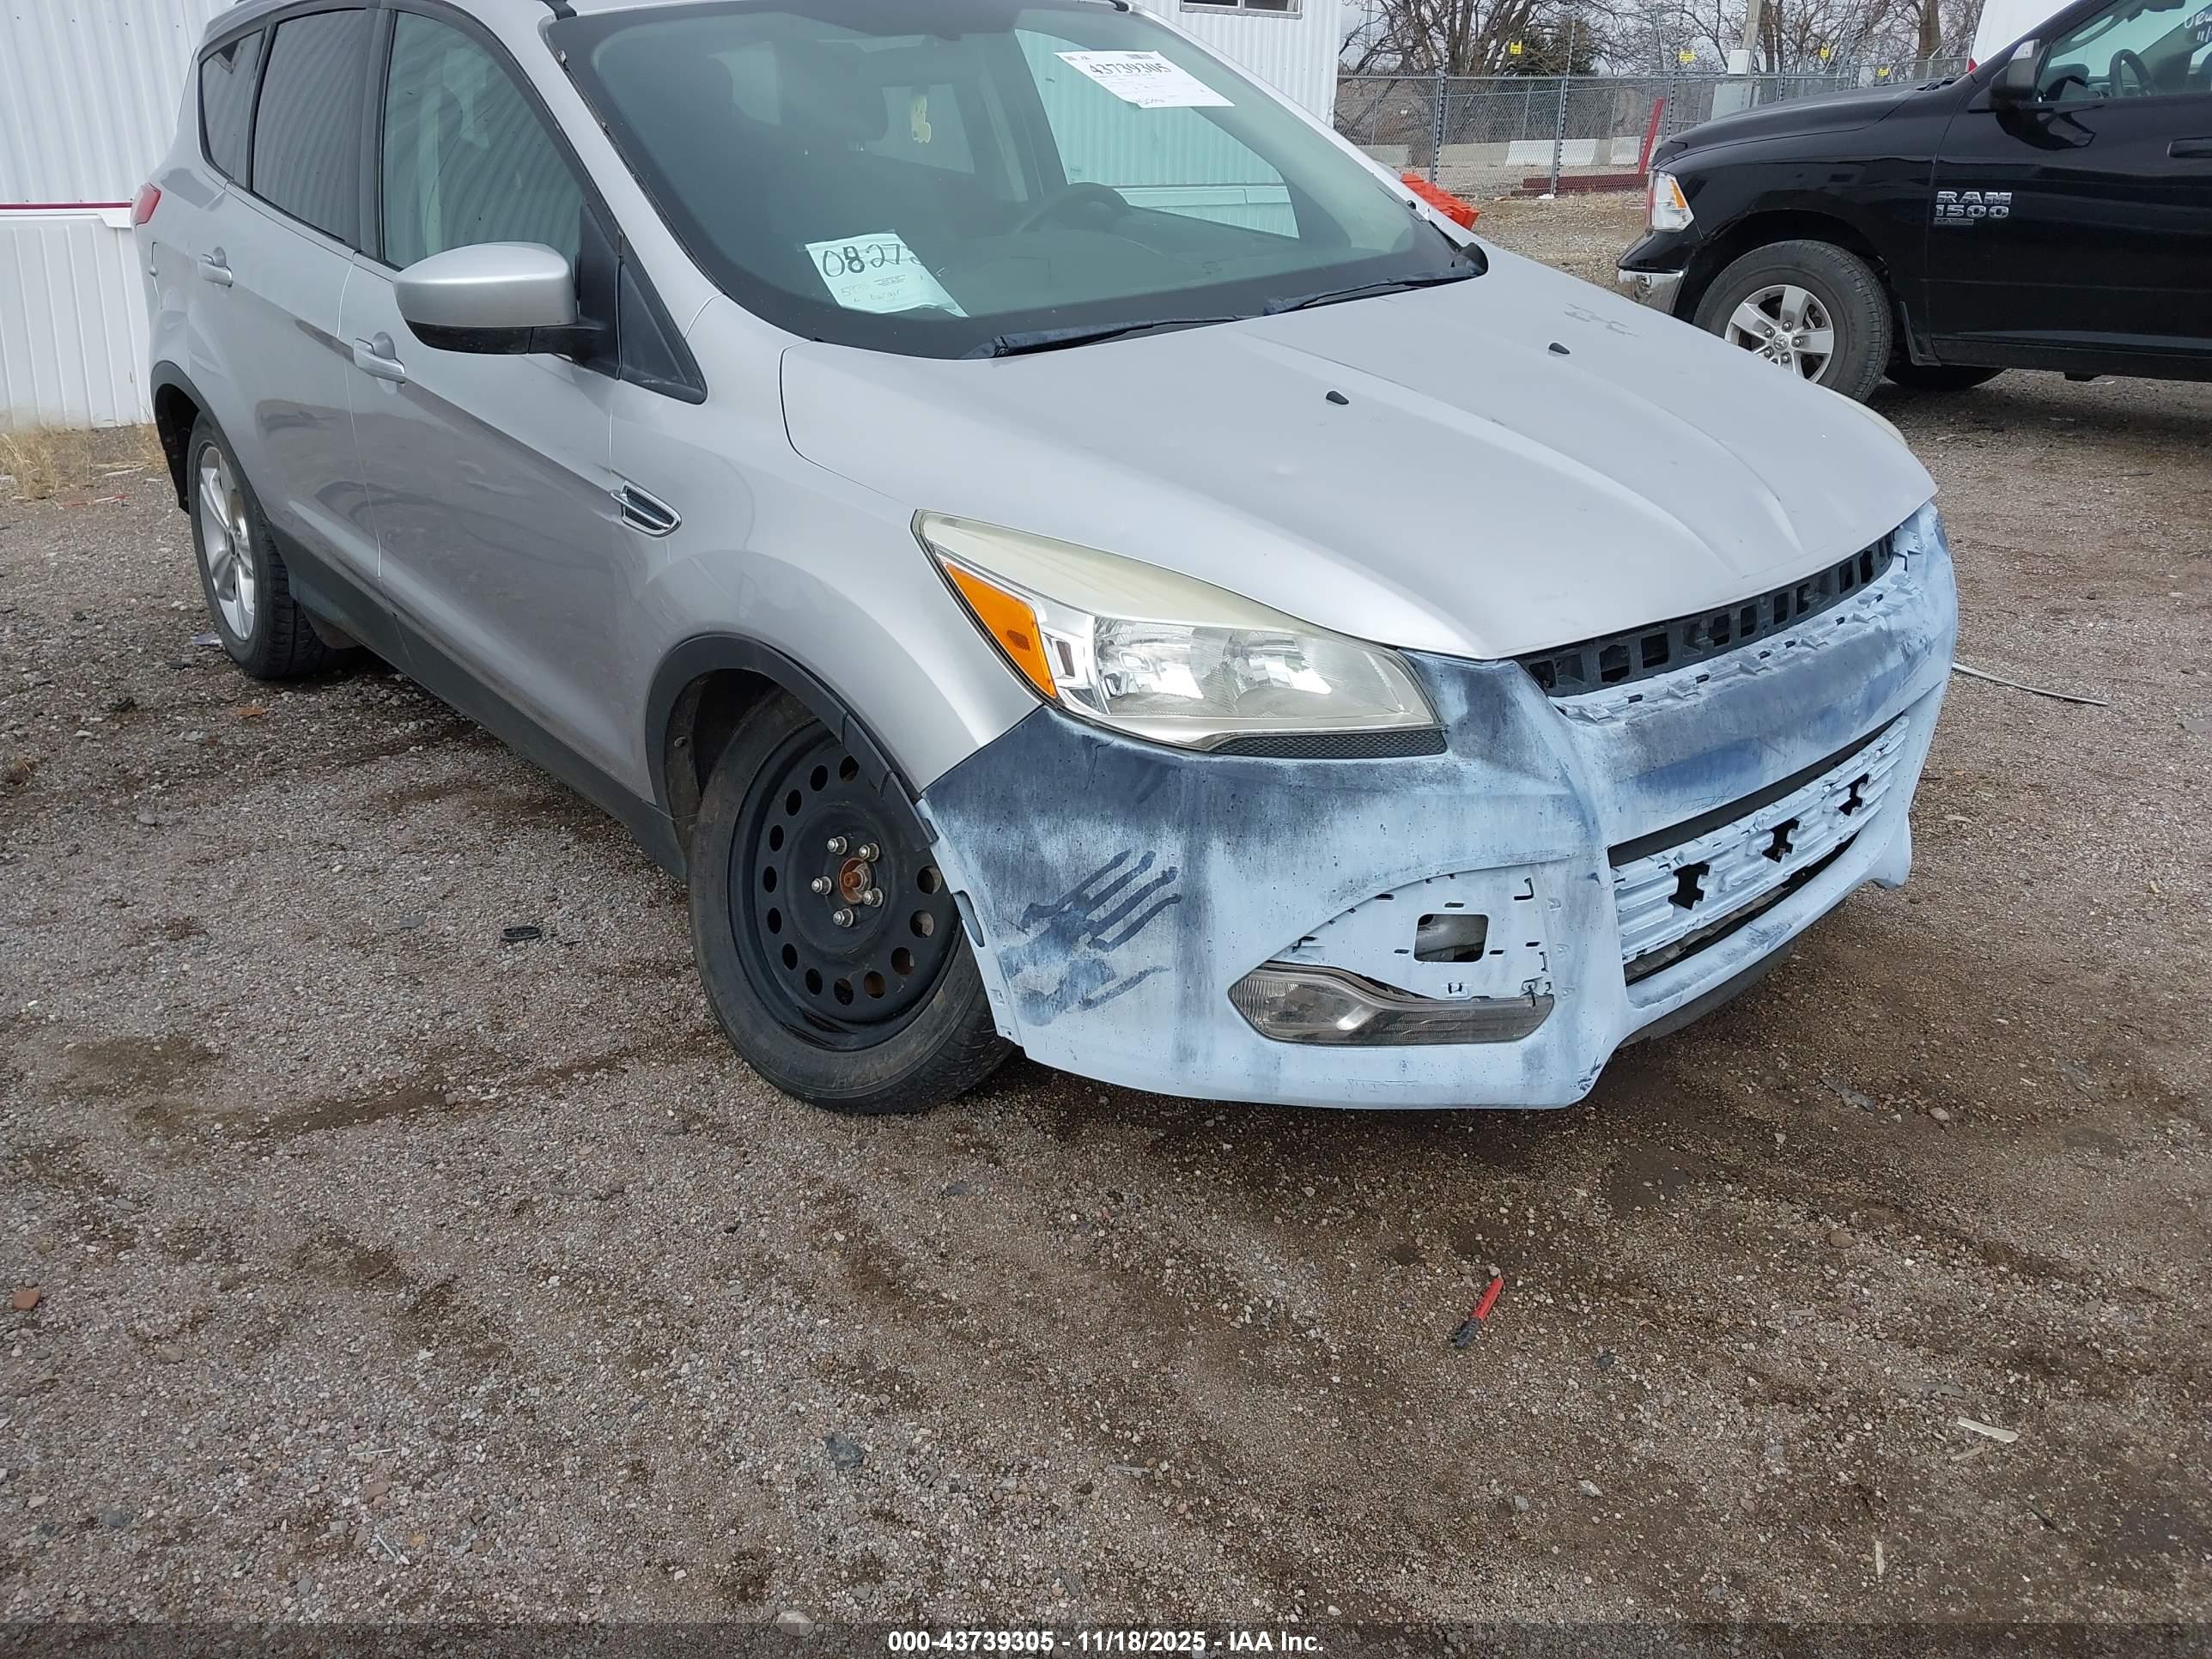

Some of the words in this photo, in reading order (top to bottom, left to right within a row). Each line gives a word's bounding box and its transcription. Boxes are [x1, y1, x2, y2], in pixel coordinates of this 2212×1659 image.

[1088, 62, 1173, 75] 43739305
[1936, 191, 2012, 204] RAM
[1936, 204, 2009, 219] 1500
